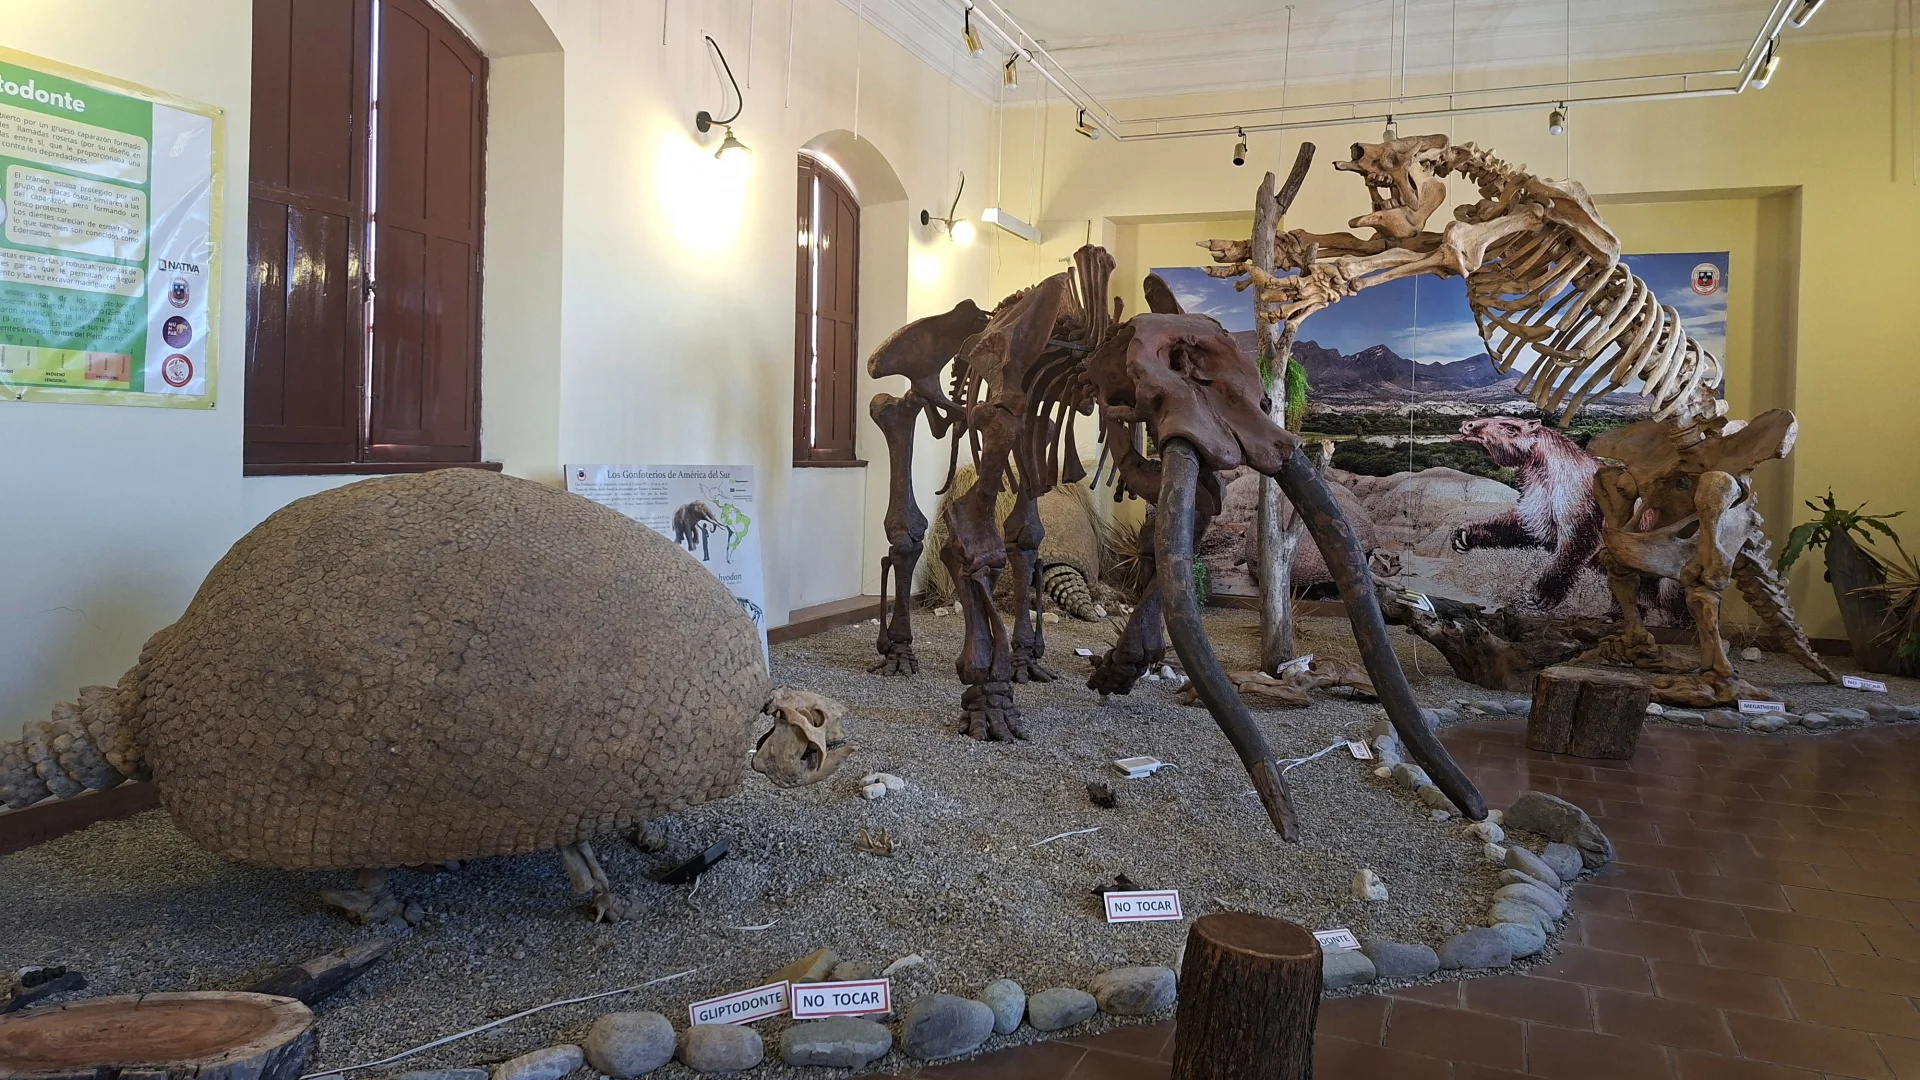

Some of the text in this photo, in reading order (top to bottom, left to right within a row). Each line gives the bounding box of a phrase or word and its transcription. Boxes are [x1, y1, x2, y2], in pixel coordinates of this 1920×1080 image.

[17, 125, 49, 138] llamadas
[52, 134, 77, 144] rosetas
[80, 139, 94, 149] (por
[108, 146, 129, 156] diseño
[51, 125, 75, 135] grueso
[77, 131, 111, 144] caparazón
[113, 138, 141, 150] formado
[1, 140, 90, 163] contra los depredadores.
[13, 134, 33, 143] entre
[49, 142, 63, 150] que
[77, 148, 124, 163] proporcionaba
[25, 175, 50, 184] cráneo
[54, 181, 77, 189] estaba
[80, 186, 112, 197] protegido
[13, 182, 36, 191] grupo
[49, 188, 71, 197] placas
[93, 197, 123, 207] similares
[13, 200, 33, 208] casco
[73, 202, 89, 210] pero
[94, 204, 127, 216] formando
[13, 208, 26, 216] Los
[29, 211, 55, 220] dientes
[39, 222, 69, 231] también
[86, 230, 119, 240] conocidos
[121, 235, 139, 243] como
[37, 256, 59, 265] cortas
[168, 260, 200, 274] NATIVA
[46, 275, 73, 284] excavar
[59, 267, 66, 275] le
[106, 275, 137, 284] conseguir
[76, 296, 87, 304] los
[32, 328, 74, 338] sedimentos
[607, 469, 731, 479] Los Gonfoterios de América del Sur
[1743, 703, 1780, 711] MEGATHERIO
[1114, 900, 1173, 913] NO TOCAR
[1319, 935, 1350, 945] DONTE
[699, 991, 880, 1022] GLIPTODONTE NO TOCAR
